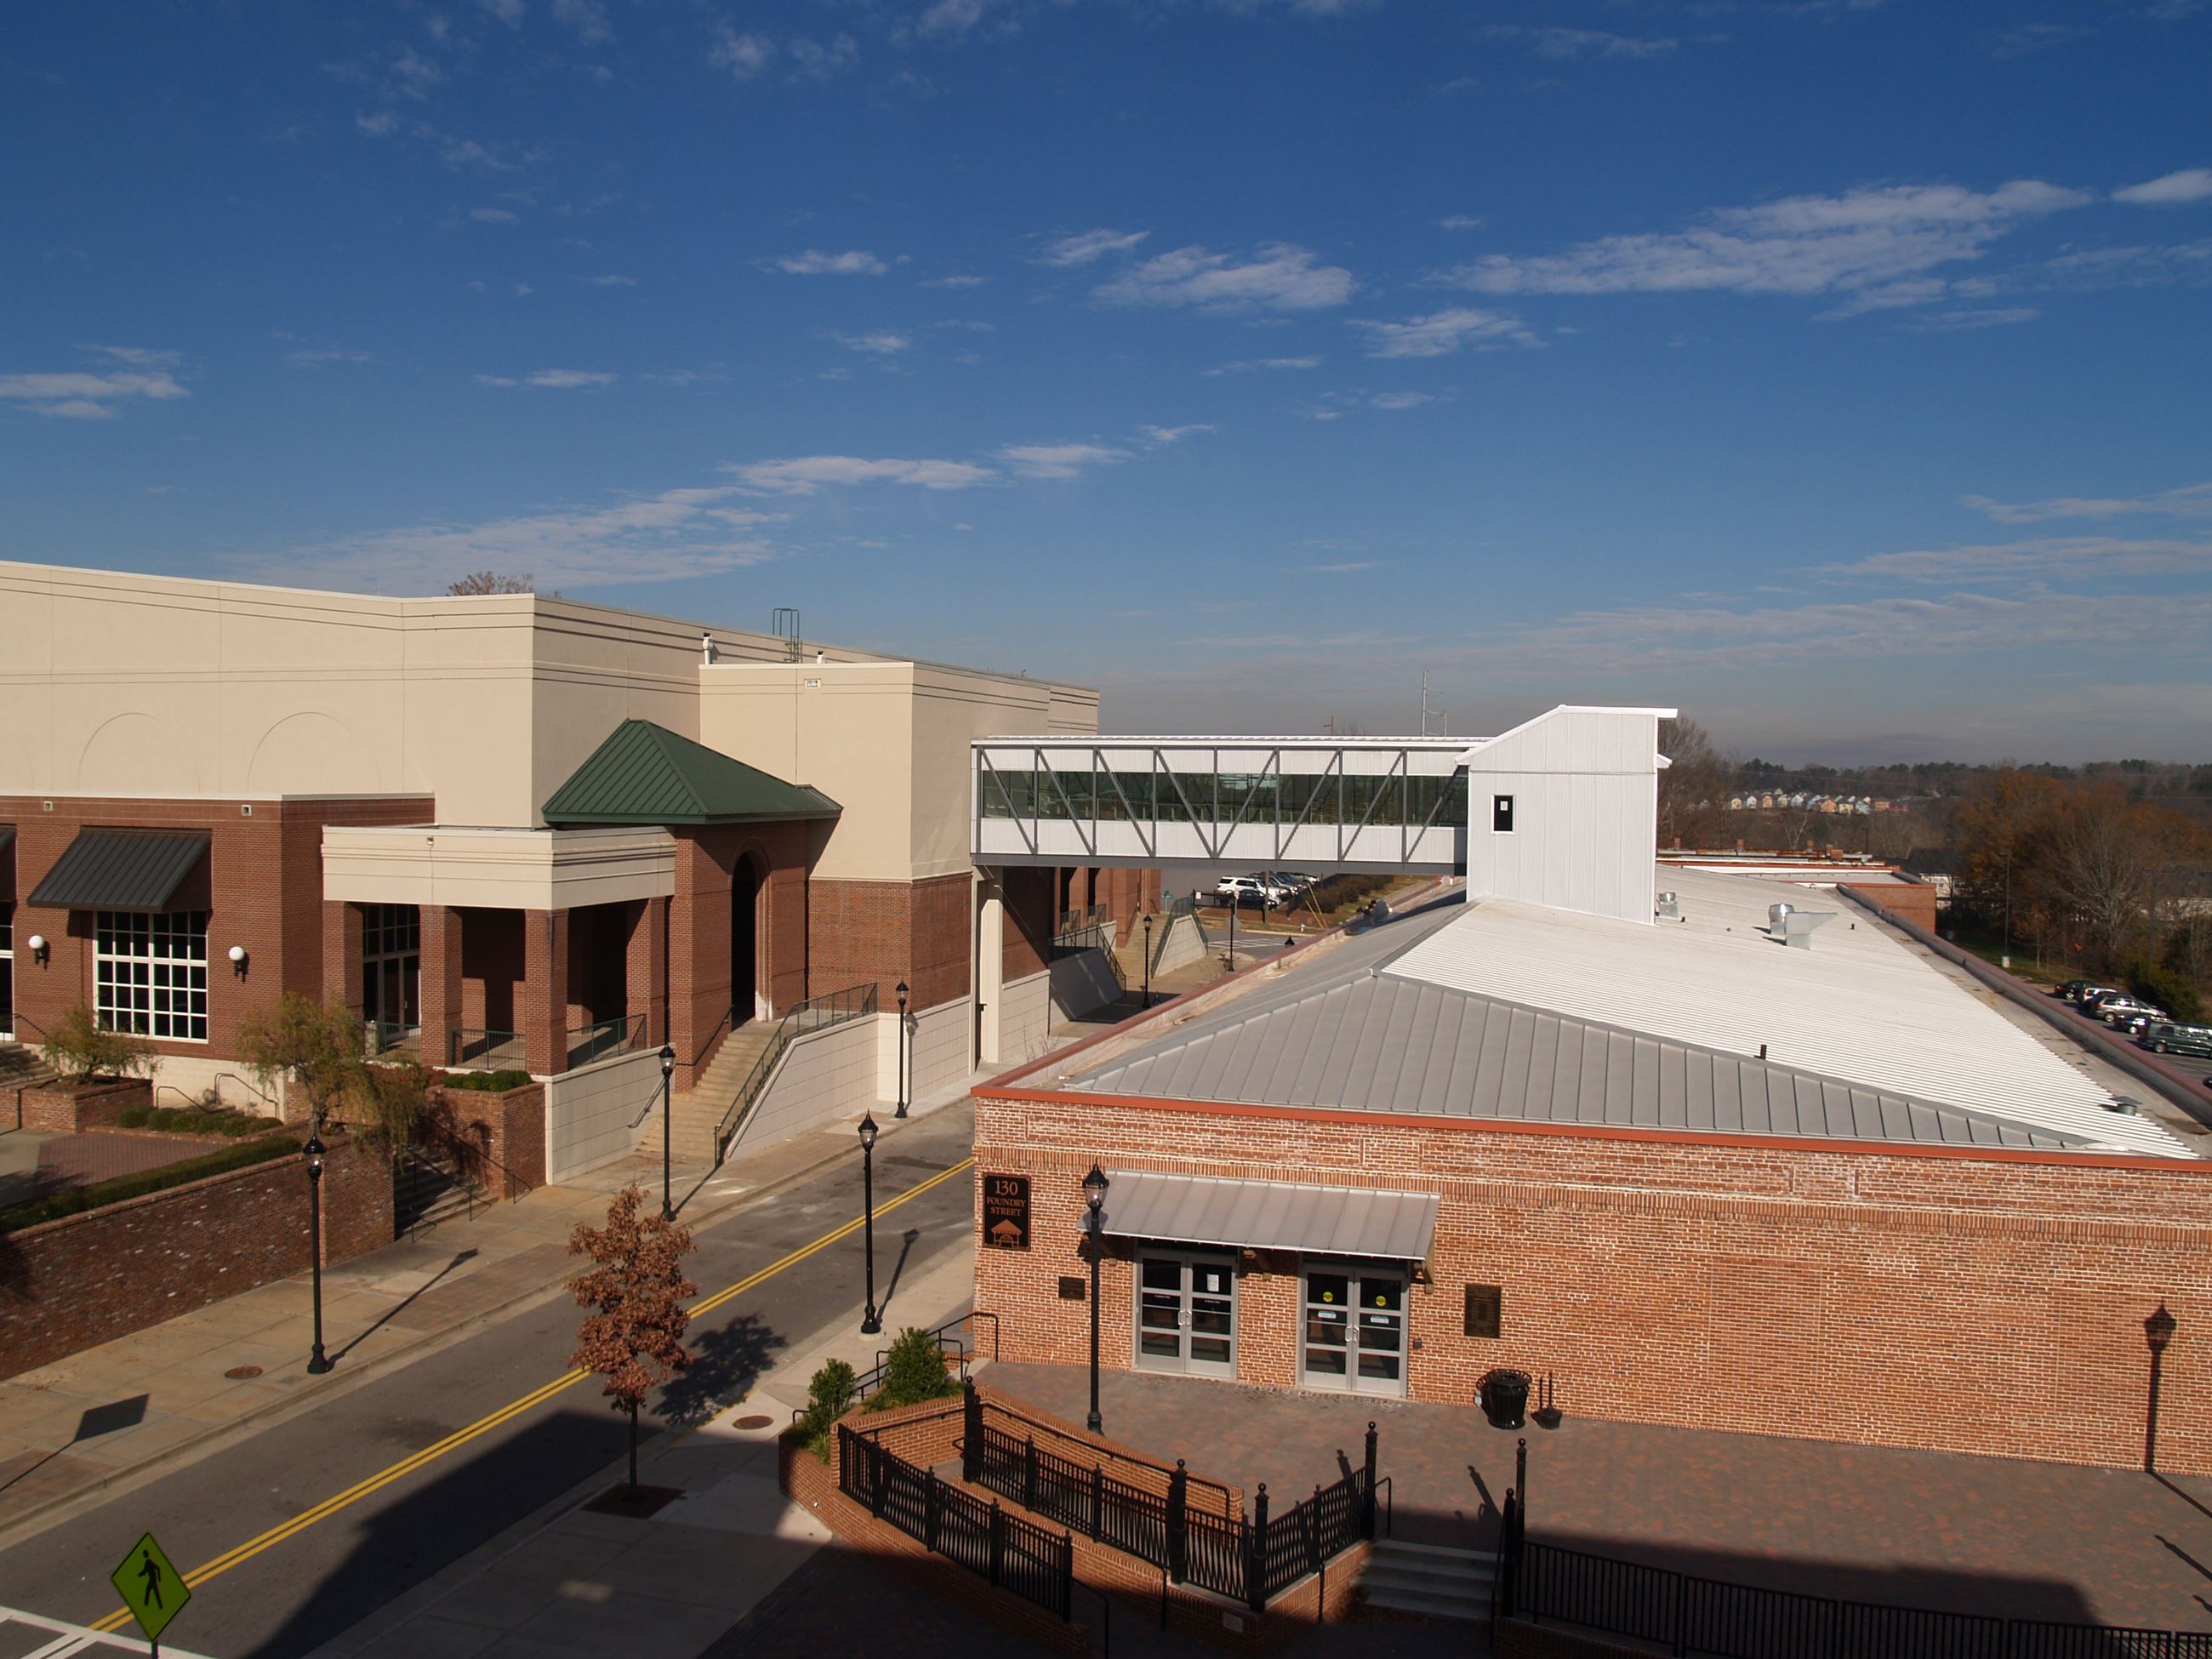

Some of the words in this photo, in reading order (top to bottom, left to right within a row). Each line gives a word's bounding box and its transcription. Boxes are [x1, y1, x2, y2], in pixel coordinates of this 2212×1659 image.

[995, 1180, 1018, 1195] 130
[986, 1196, 1026, 1207] FOUNDRY
[990, 1206, 1022, 1217] STREET
